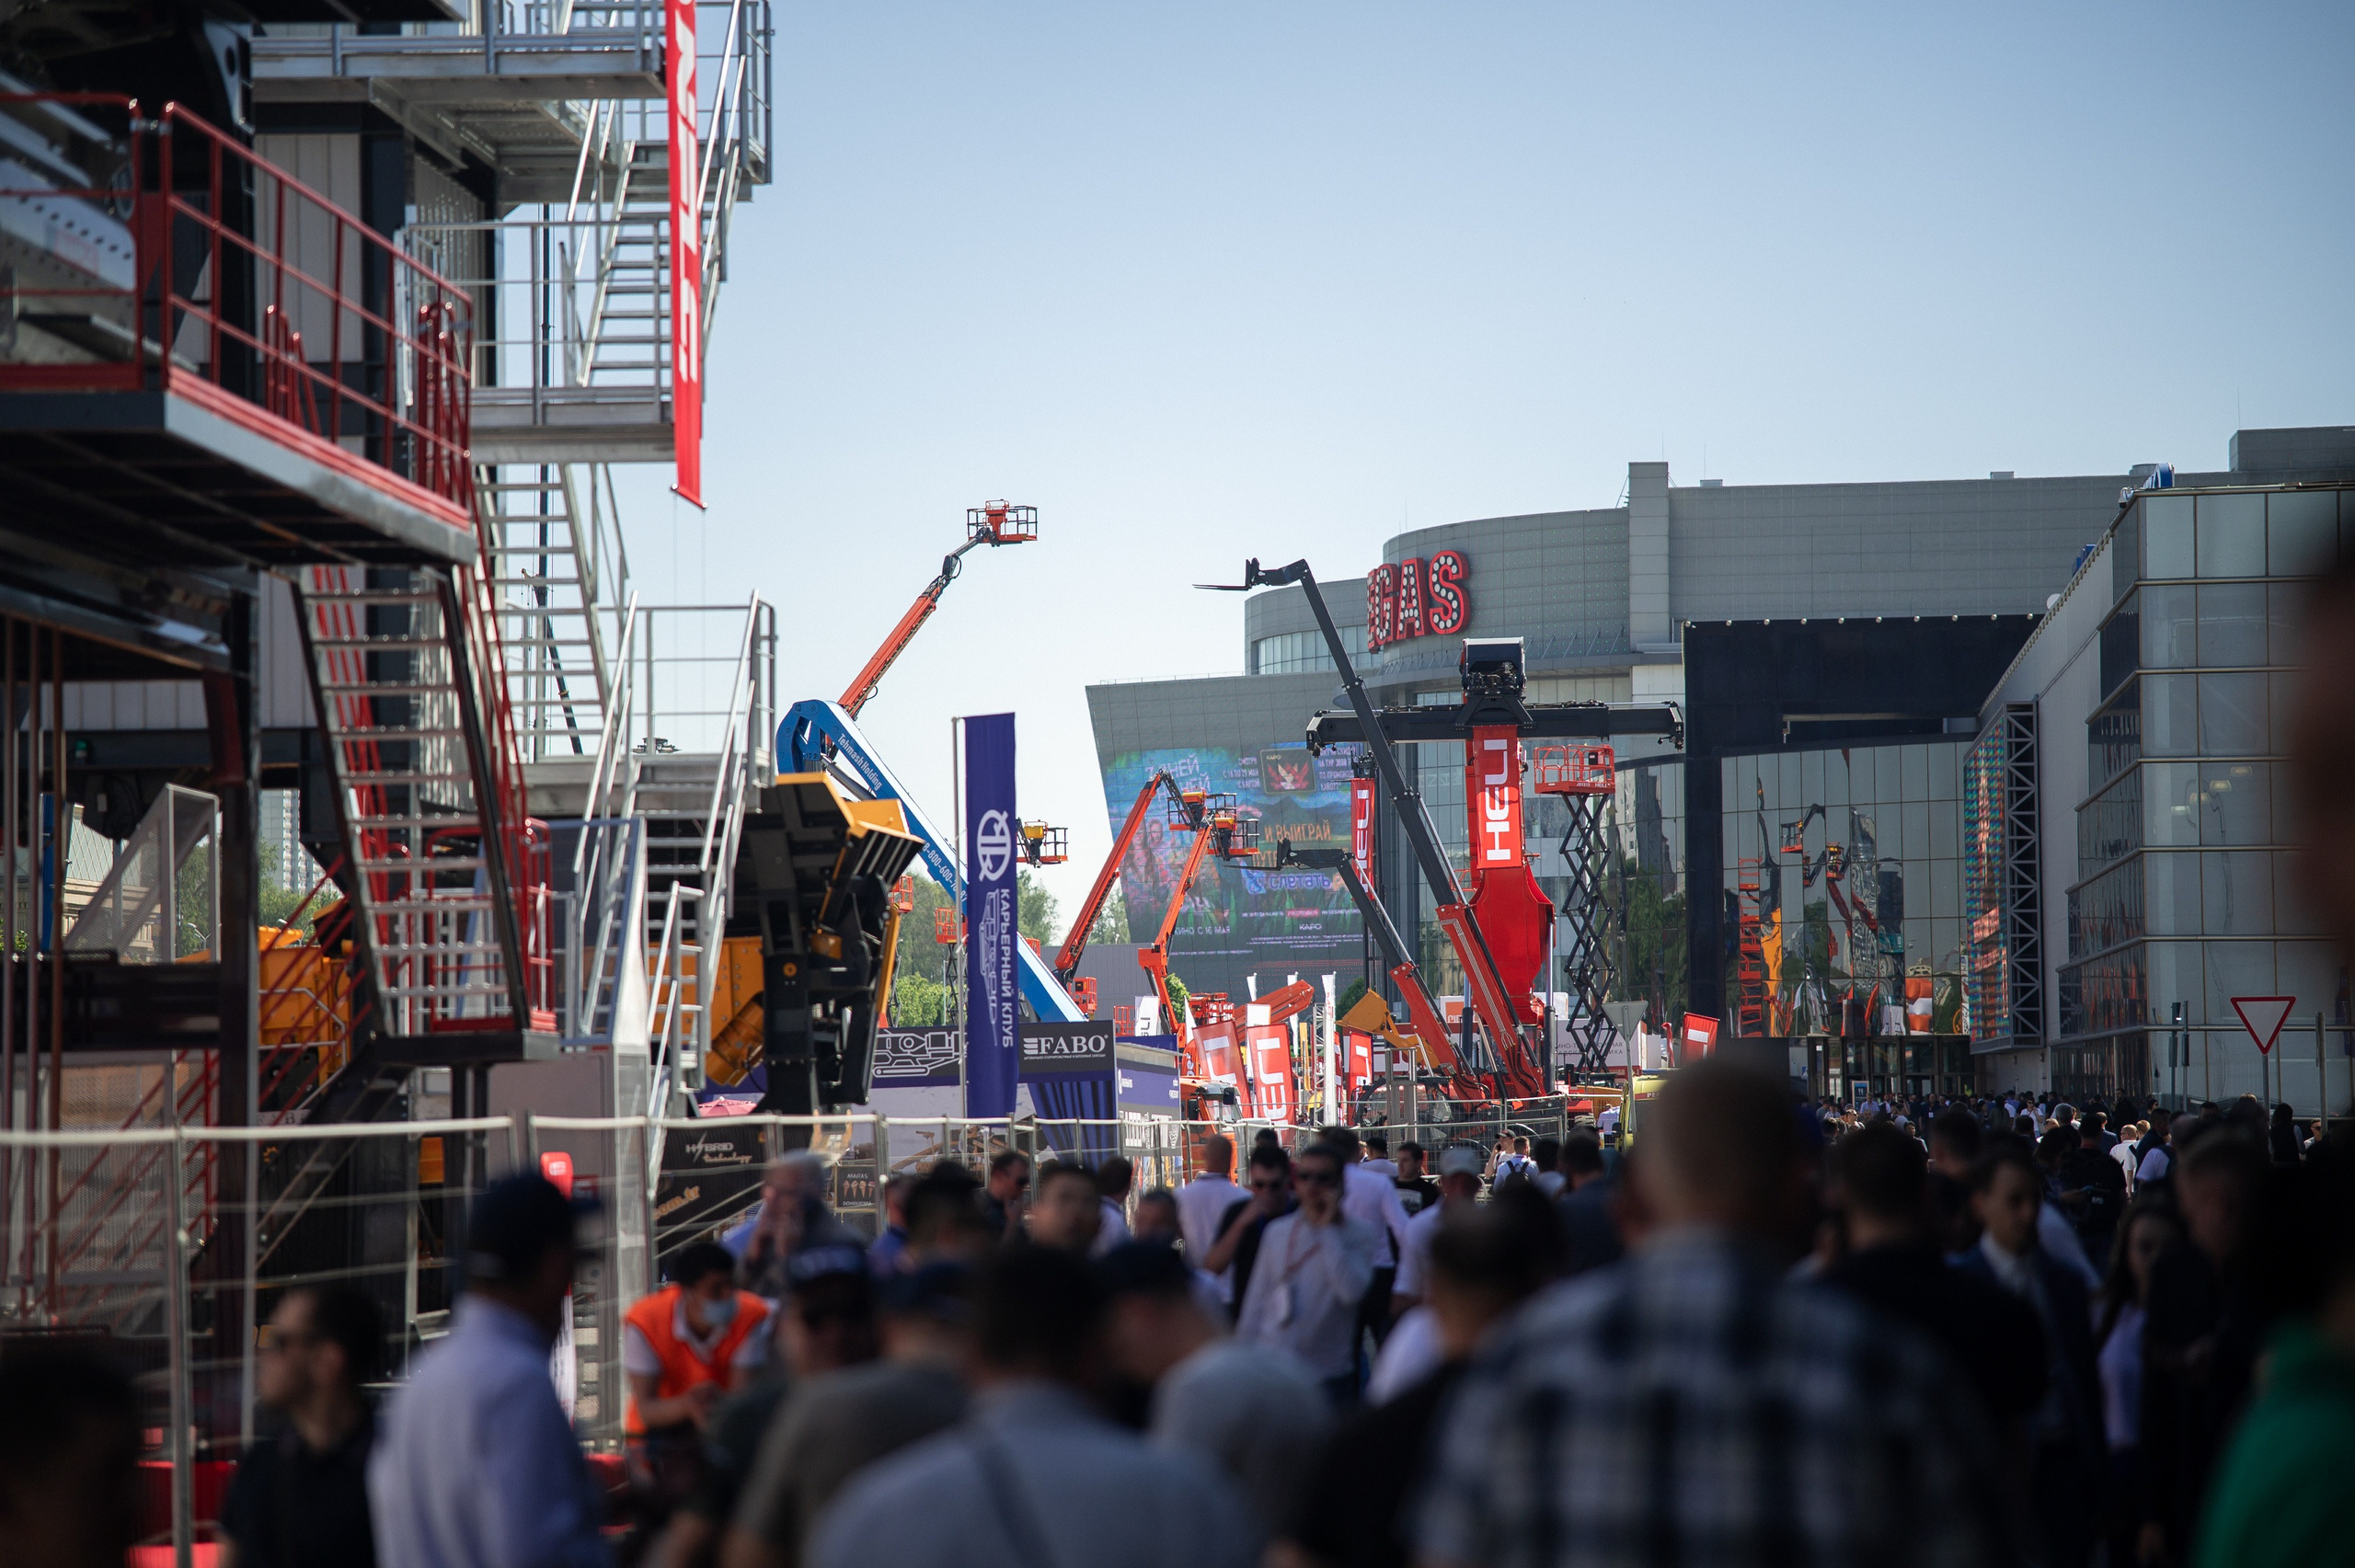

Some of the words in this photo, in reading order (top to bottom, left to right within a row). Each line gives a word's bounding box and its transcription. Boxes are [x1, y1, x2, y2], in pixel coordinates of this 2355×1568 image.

[1367, 550, 1469, 651] EGAS
[837, 733, 864, 767] Tehmash
[861, 761, 882, 791] Holding
[1484, 739, 1511, 861] HELI
[1000, 888, 1014, 998] КАРЬЕРНЫЙ
[1002, 1001, 1014, 1048] КЛУБ
[1039, 1035, 1106, 1055] FABO
